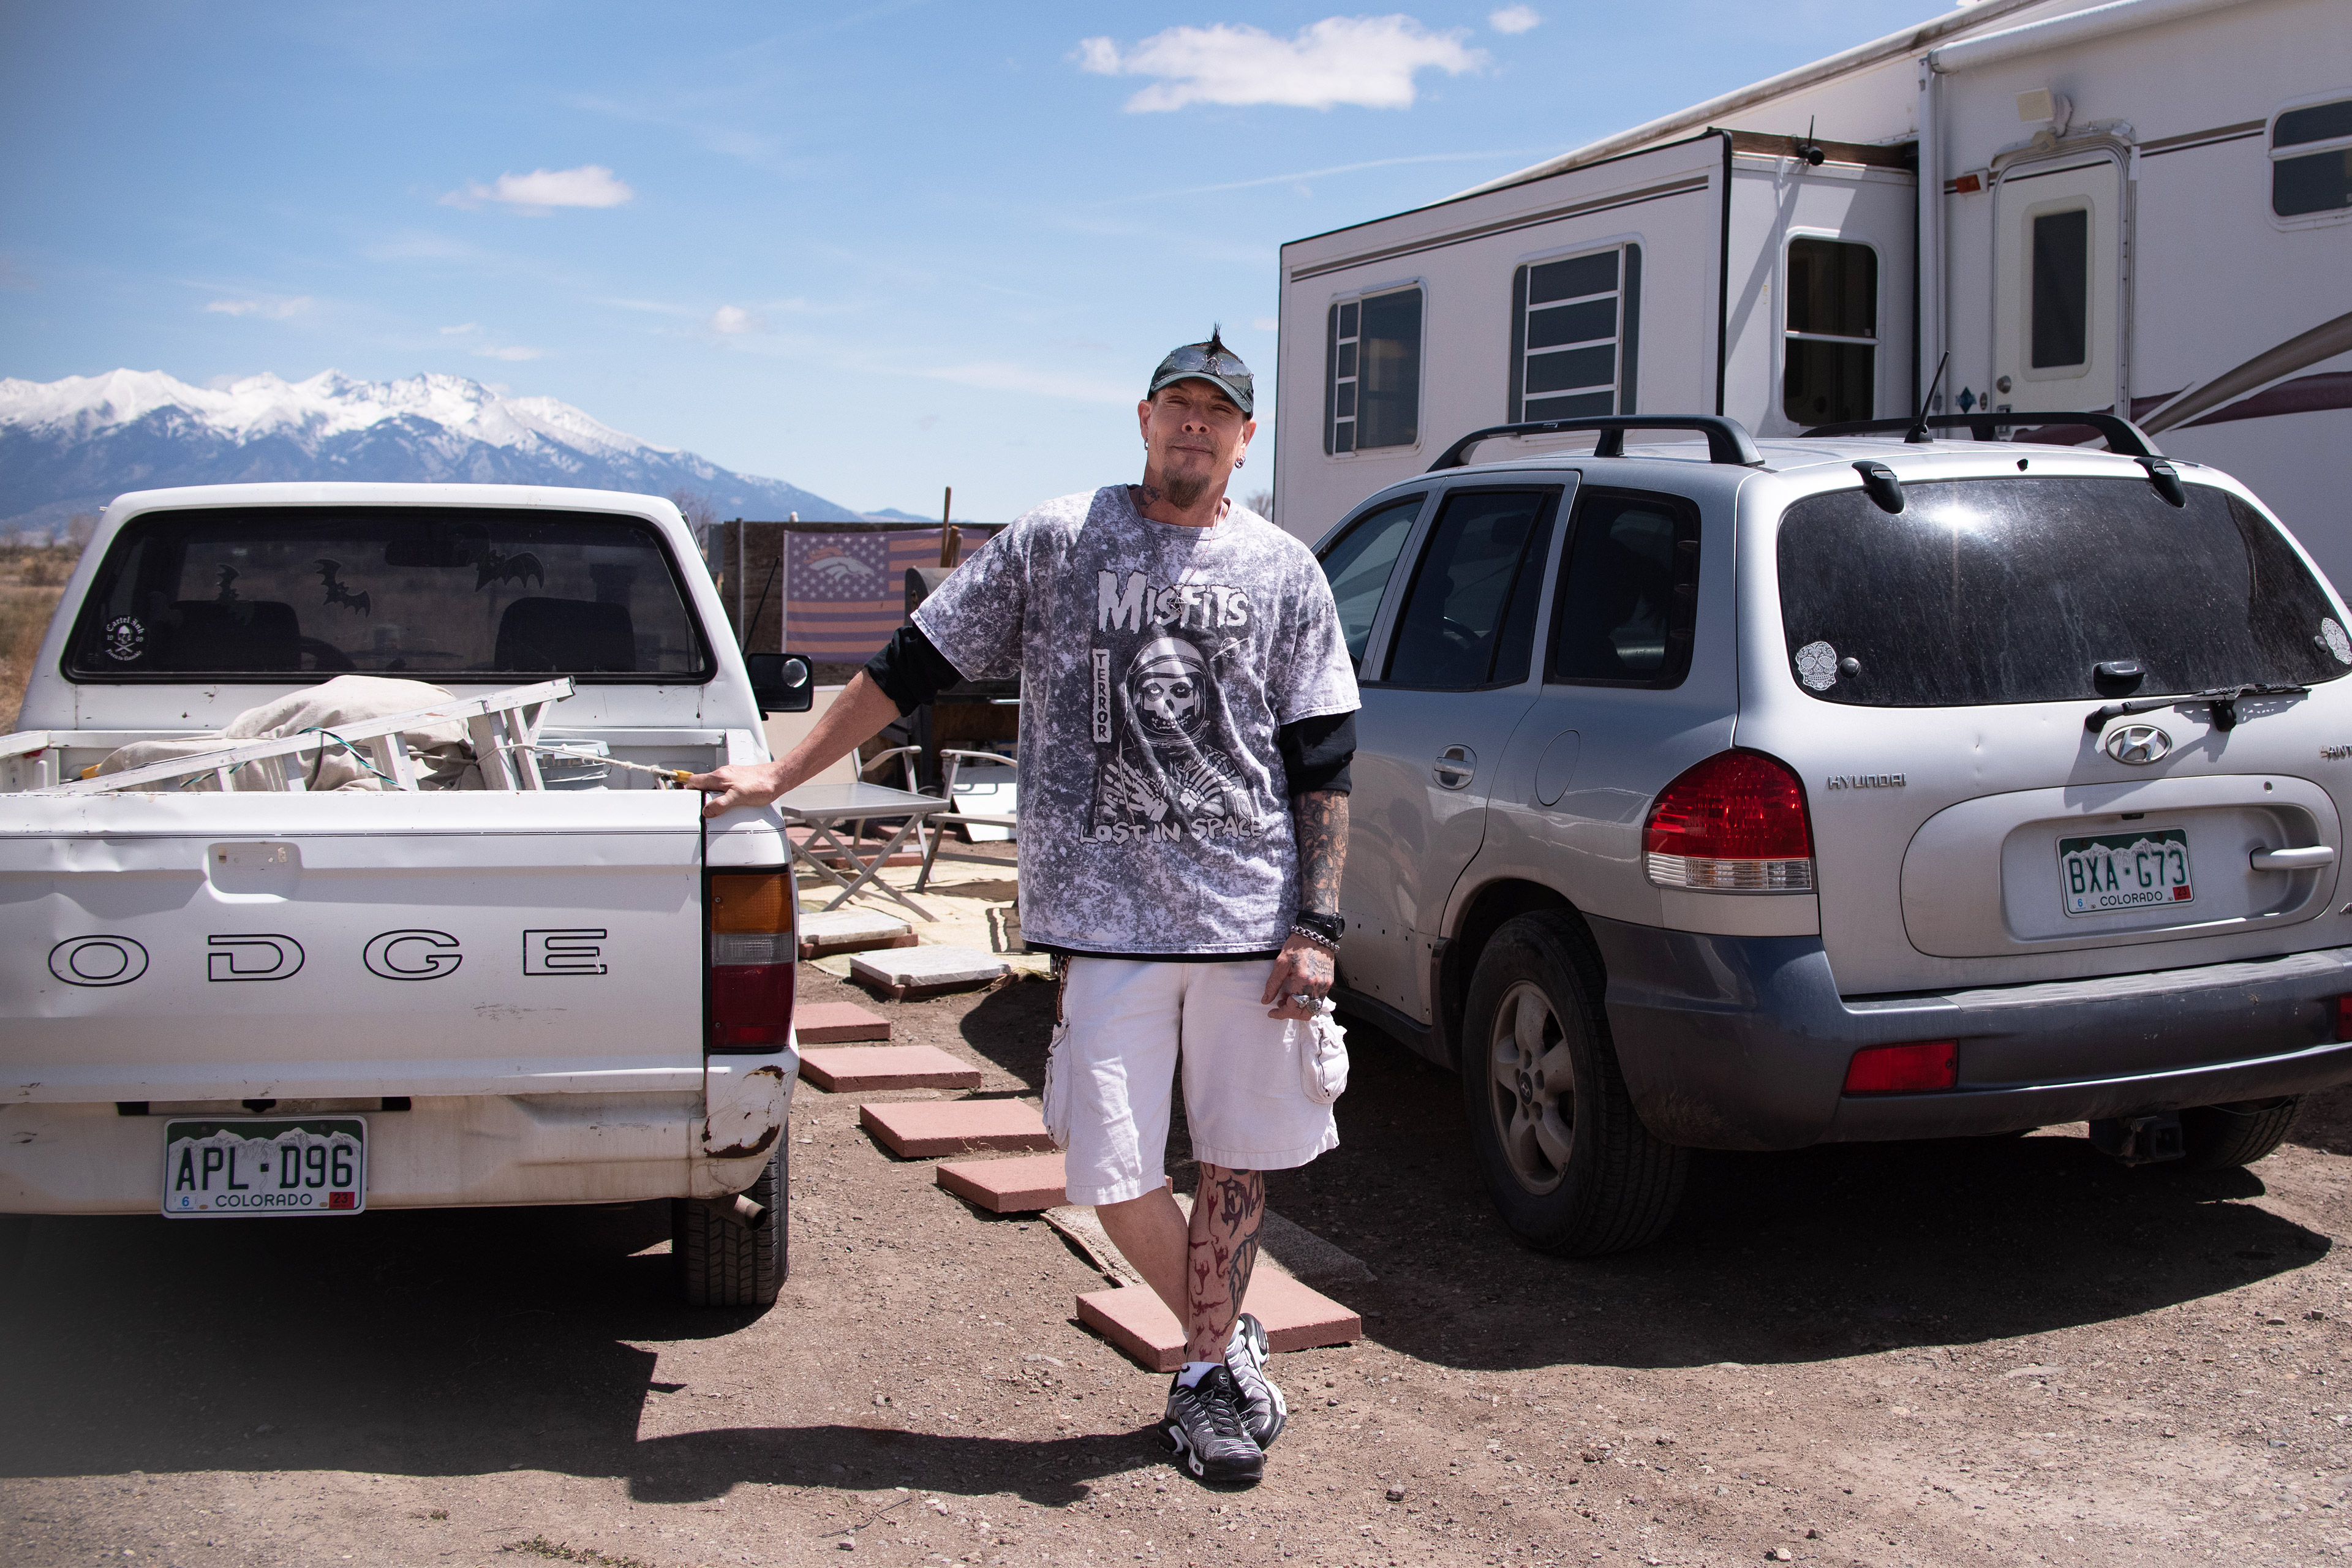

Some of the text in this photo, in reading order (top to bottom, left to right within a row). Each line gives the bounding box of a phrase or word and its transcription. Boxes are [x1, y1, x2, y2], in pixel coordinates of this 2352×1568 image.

[106, 616, 130, 631] Cartel
[1095, 652, 1107, 739] TERROR
[1828, 772, 1907, 789] HYUNDAI
[1079, 816, 1264, 845] LOST IN SPACE
[2177, 887, 2187, 896] 23
[2077, 898, 2083, 907] 6
[2100, 891, 2163, 907] COLORADO
[182, 1196, 190, 1207] 6
[216, 1193, 312, 1207] COLORADO
[333, 1193, 348, 1204] 23
